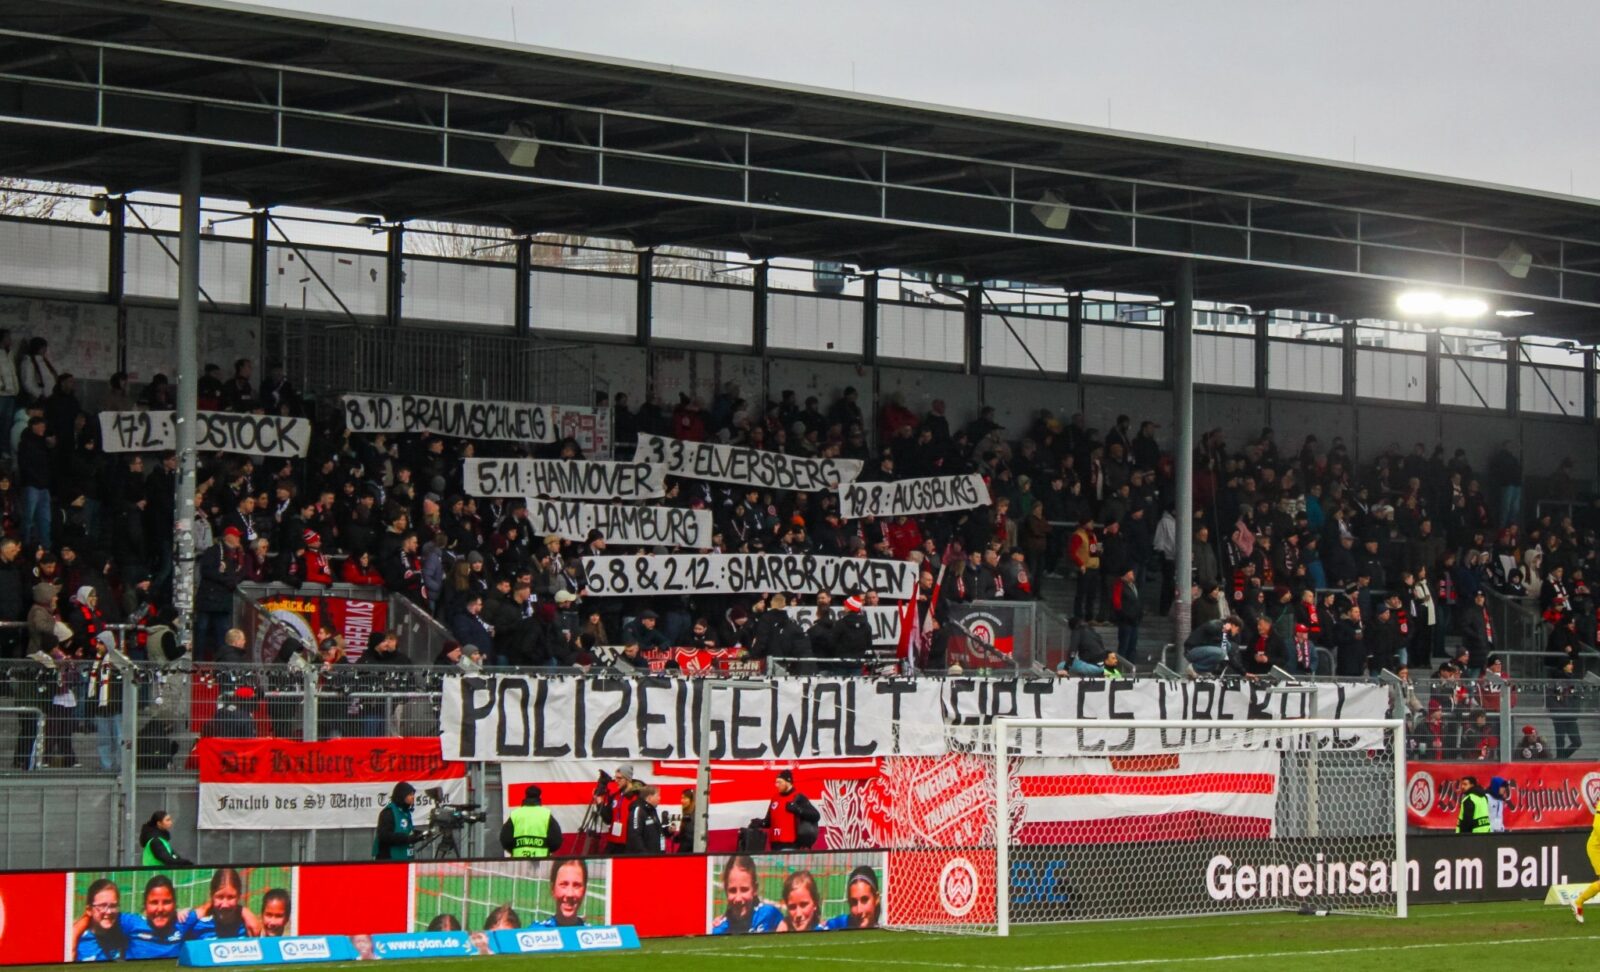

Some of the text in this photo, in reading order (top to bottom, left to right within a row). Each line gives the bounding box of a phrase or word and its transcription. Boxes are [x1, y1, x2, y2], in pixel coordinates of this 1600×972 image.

[171, 413, 300, 452] OSTOCK
[402, 396, 546, 440] BRAUNSCHWEIG
[533, 462, 654, 496] HANNOVER
[694, 444, 841, 489] ELVERSBERG
[891, 475, 978, 513] AUGSBURG
[593, 504, 698, 546] HAMBURG
[635, 557, 659, 591] &
[727, 554, 906, 594] SAARBRÜCKEN
[459, 677, 918, 758] POLIZEIGEWALT
[1076, 680, 1136, 752] ES
[216, 794, 269, 812] Fanclub
[275, 794, 298, 810] des
[1205, 846, 1569, 900] Gemeinsam am Ball.
[230, 944, 258, 955] PLAN
[299, 942, 326, 953] PLAN
[386, 937, 460, 952] www.plan.de
[534, 934, 559, 944] PLAN
[594, 931, 617, 942] PLAN
